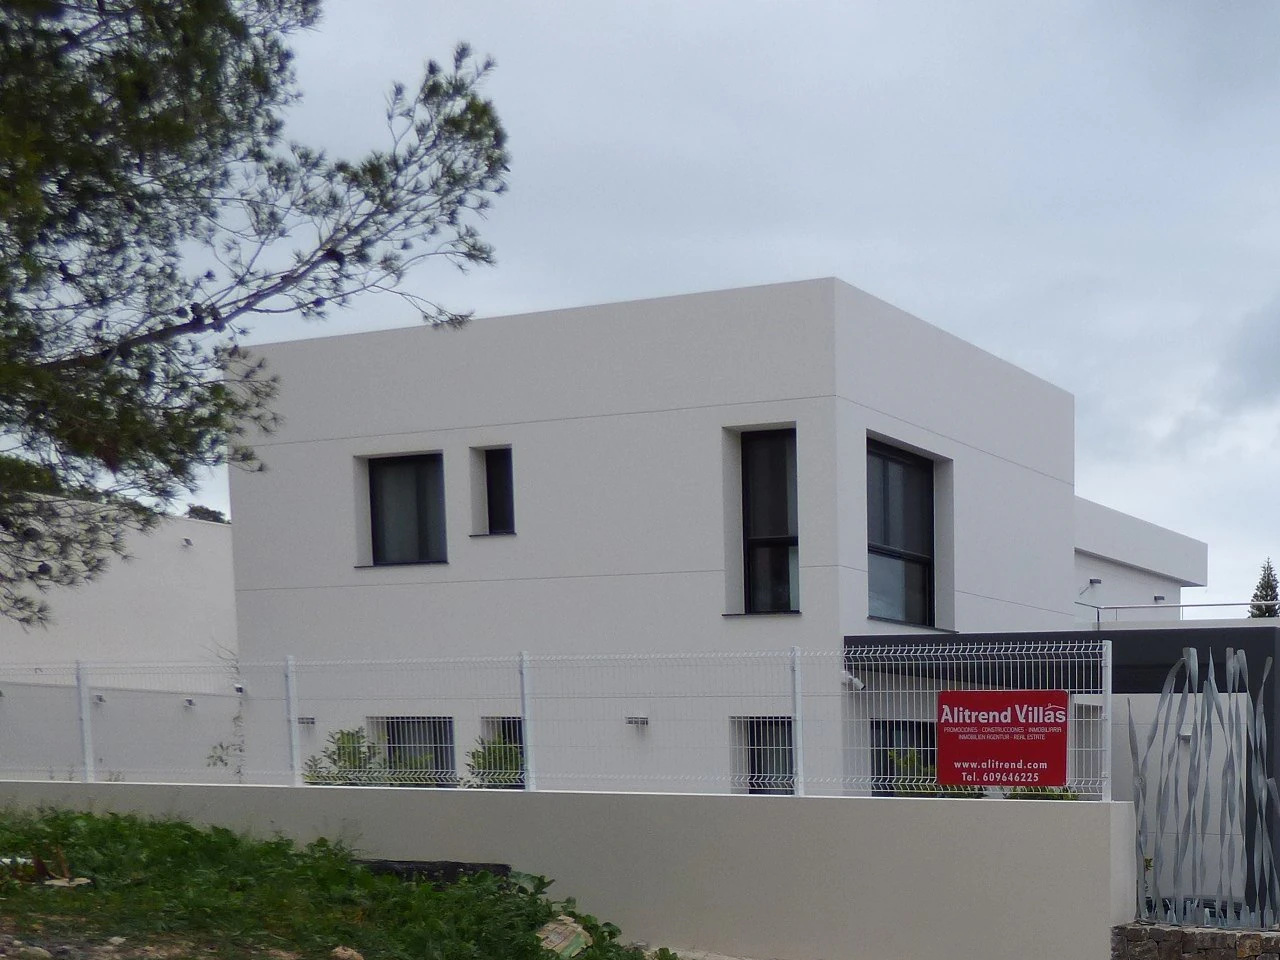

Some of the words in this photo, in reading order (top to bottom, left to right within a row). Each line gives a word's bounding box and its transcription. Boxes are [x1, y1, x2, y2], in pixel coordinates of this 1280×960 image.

[941, 704, 1011, 723] Alitrend
[954, 759, 1048, 769] www.alitrend.com
[961, 772, 980, 782] Tel.
[982, 772, 1039, 782] 609646225
